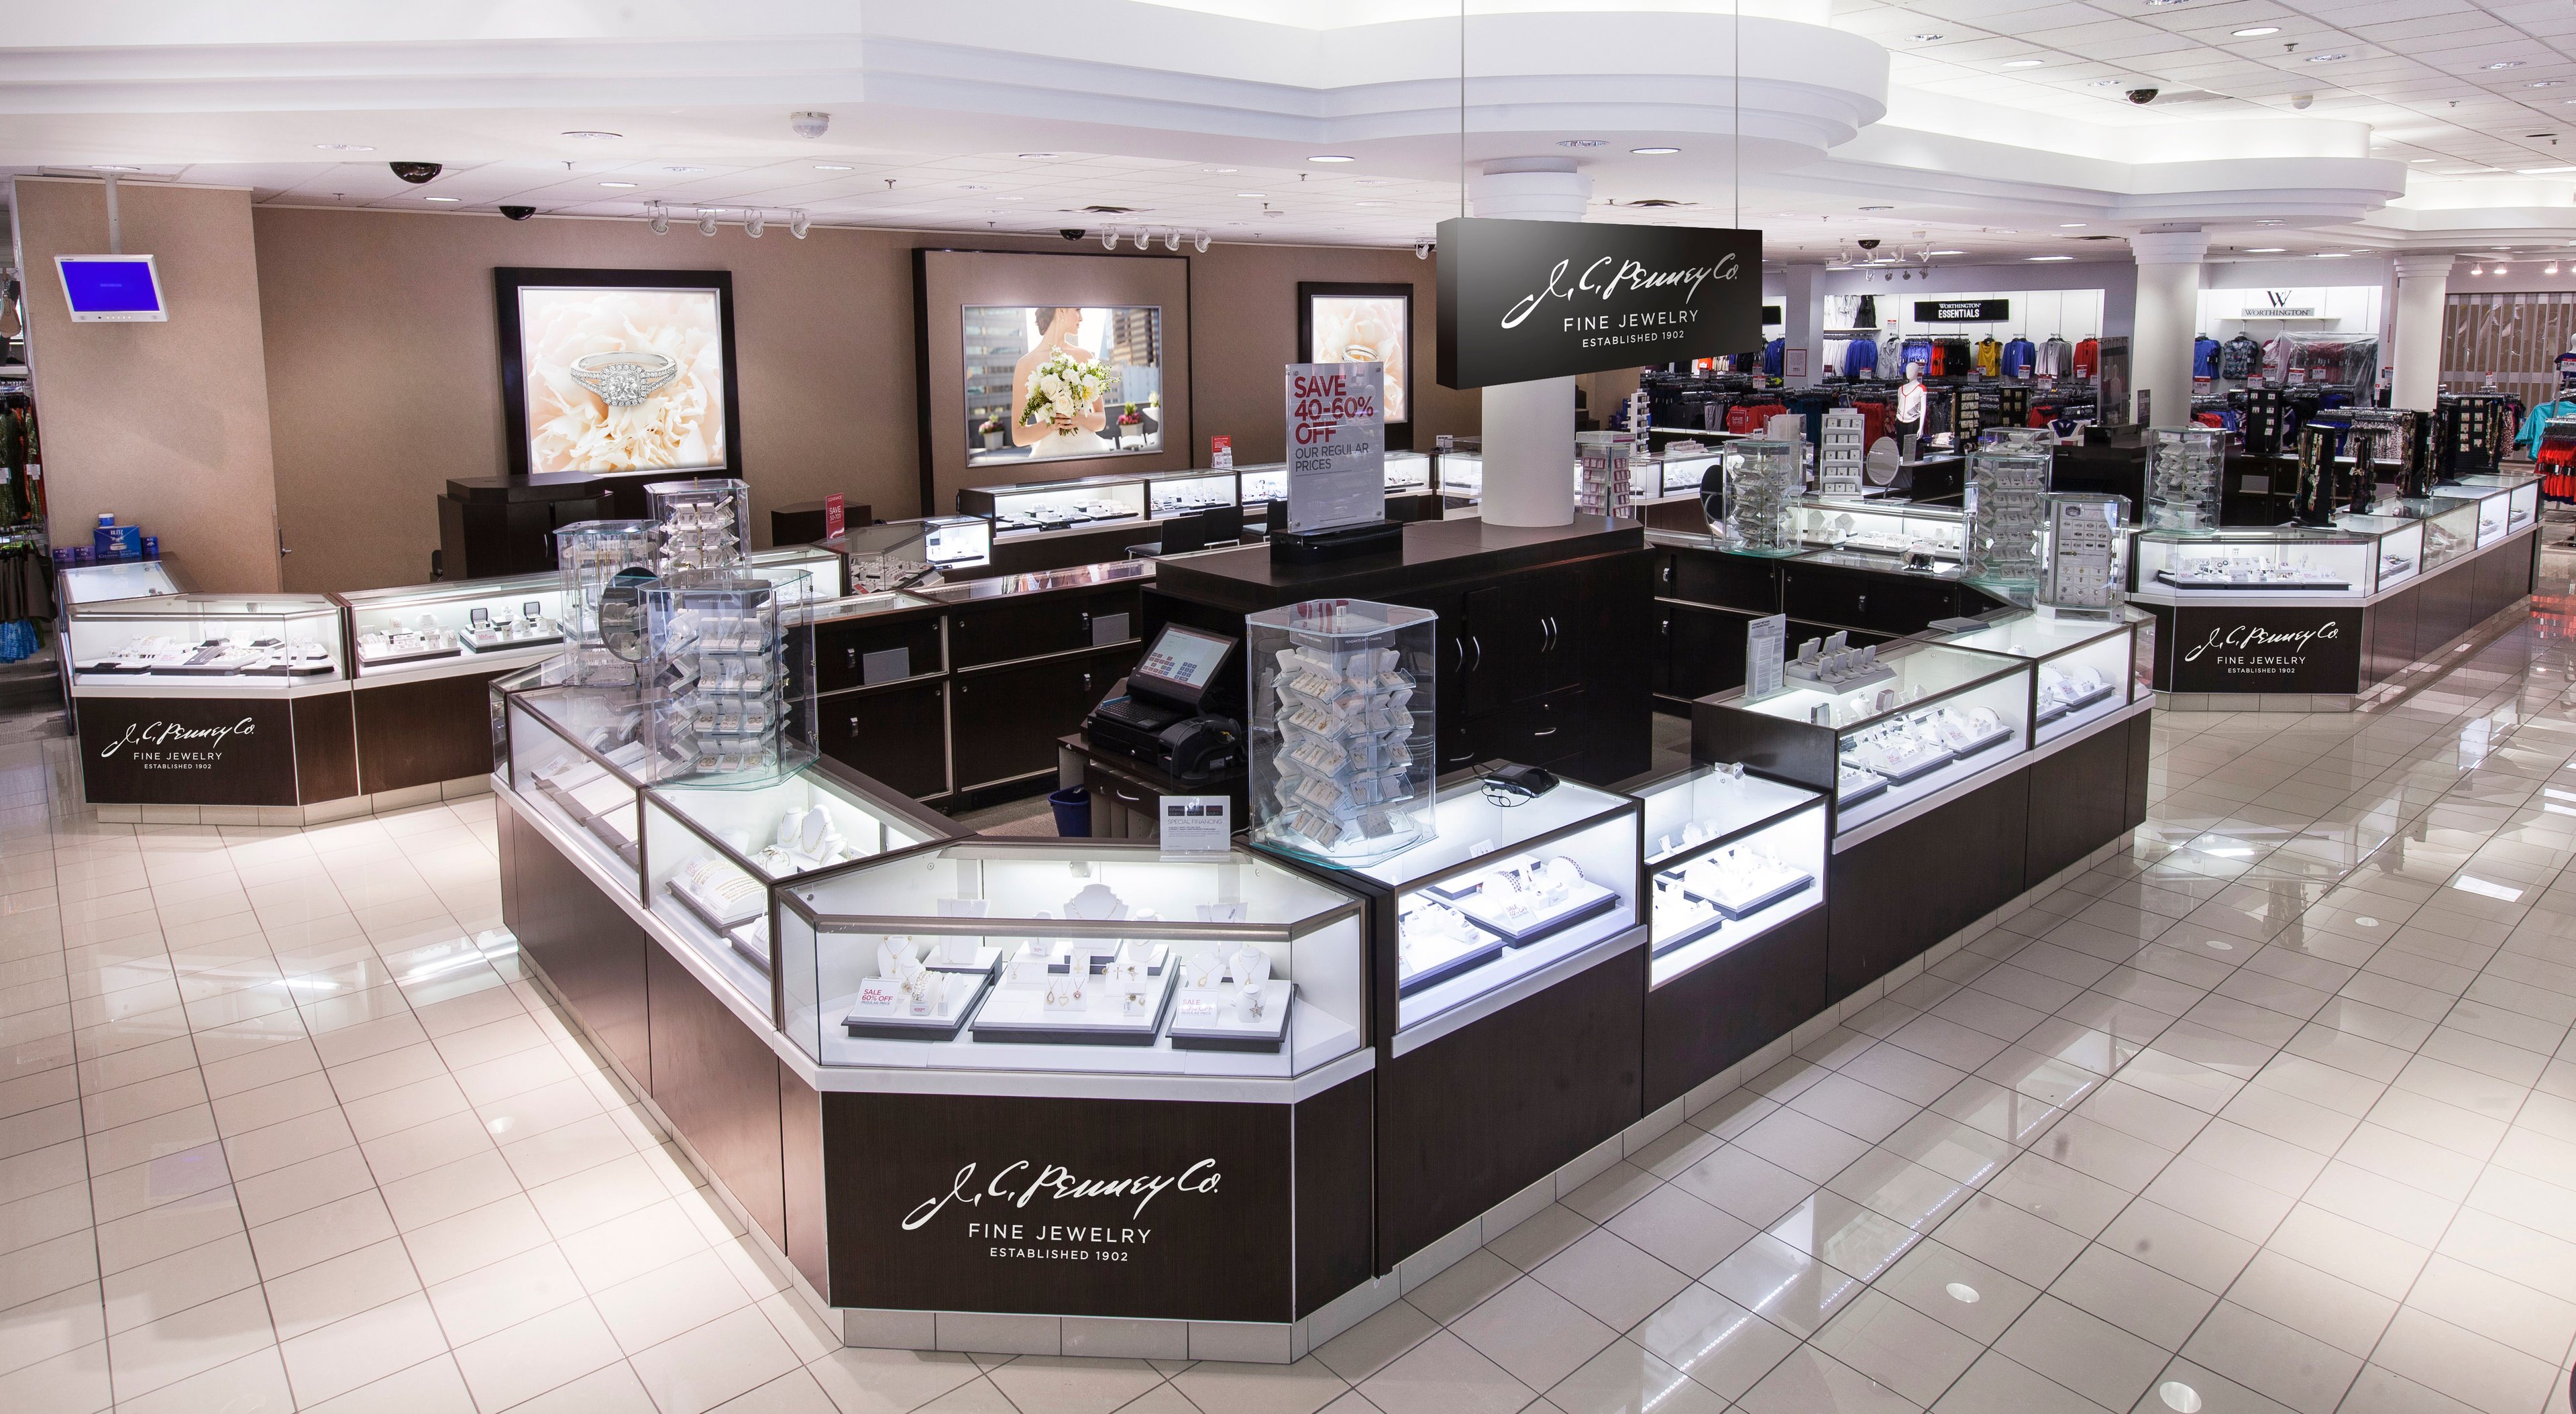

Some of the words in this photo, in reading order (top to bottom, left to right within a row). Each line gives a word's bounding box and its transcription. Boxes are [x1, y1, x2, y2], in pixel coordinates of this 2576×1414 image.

[1603, 259, 1712, 305] Penney
[1713, 252, 1738, 280] Co.
[1564, 316, 1609, 333] FINE
[1619, 309, 1699, 329] JEWELRY
[1938, 309, 1980, 318] ESSENTIALS
[1582, 333, 1658, 348] ESTABLISHED
[1662, 330, 1684, 340] 1902
[1294, 374, 1346, 398] SAVE
[1294, 396, 1374, 421] 40-60%
[1295, 421, 1336, 445] OFF
[1295, 446, 1318, 459] OUR
[1321, 443, 1369, 457] REGULAR
[1295, 458, 1332, 472] PRICES
[829, 505, 841, 514] SAVE
[2240, 627, 2316, 653] Penney
[2317, 621, 2339, 639] Co.
[156, 722, 233, 749] Penney
[234, 717, 255, 735] Co.
[133, 752, 160, 760] FINE
[166, 752, 223, 760] JEWELRY
[1506, 904, 1518, 912] SALE
[1016, 1164, 1175, 1219] Penney
[1178, 1158, 1222, 1193] Co.
[969, 1223, 1024, 1240] FINE
[1036, 1226, 1152, 1244] JEWELRY
[990, 1248, 1089, 1260] ESTABLISHED
[1095, 1251, 1128, 1262] 1902
